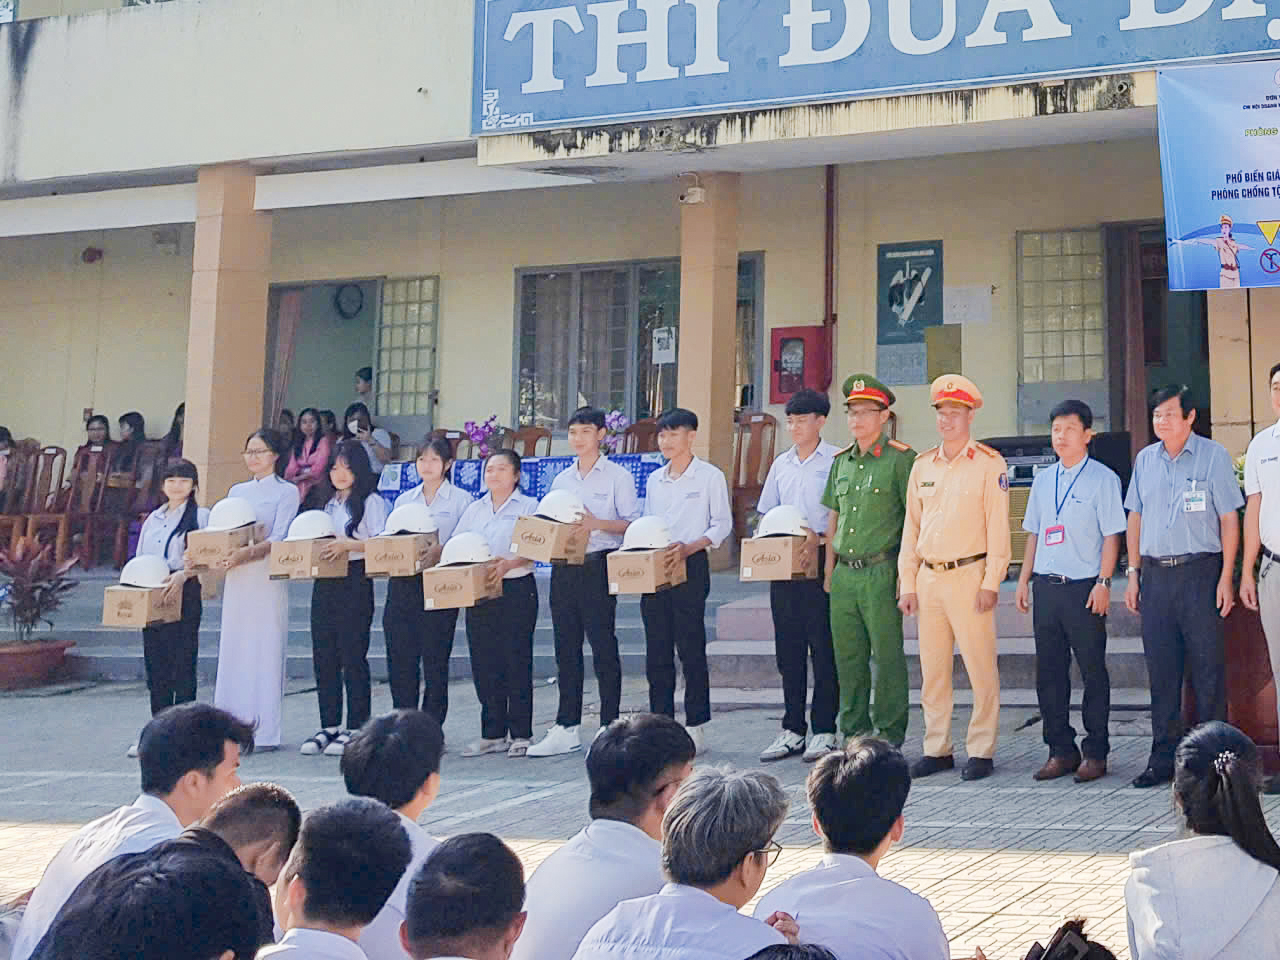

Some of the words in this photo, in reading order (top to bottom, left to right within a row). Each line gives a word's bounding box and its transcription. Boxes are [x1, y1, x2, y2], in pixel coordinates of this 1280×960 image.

[1226, 169, 1242, 184] PHỔ
[1244, 168, 1264, 182] BIẾN
[1211, 187, 1239, 200] PHÒNG
[1241, 185, 1269, 198] CHỐNG
